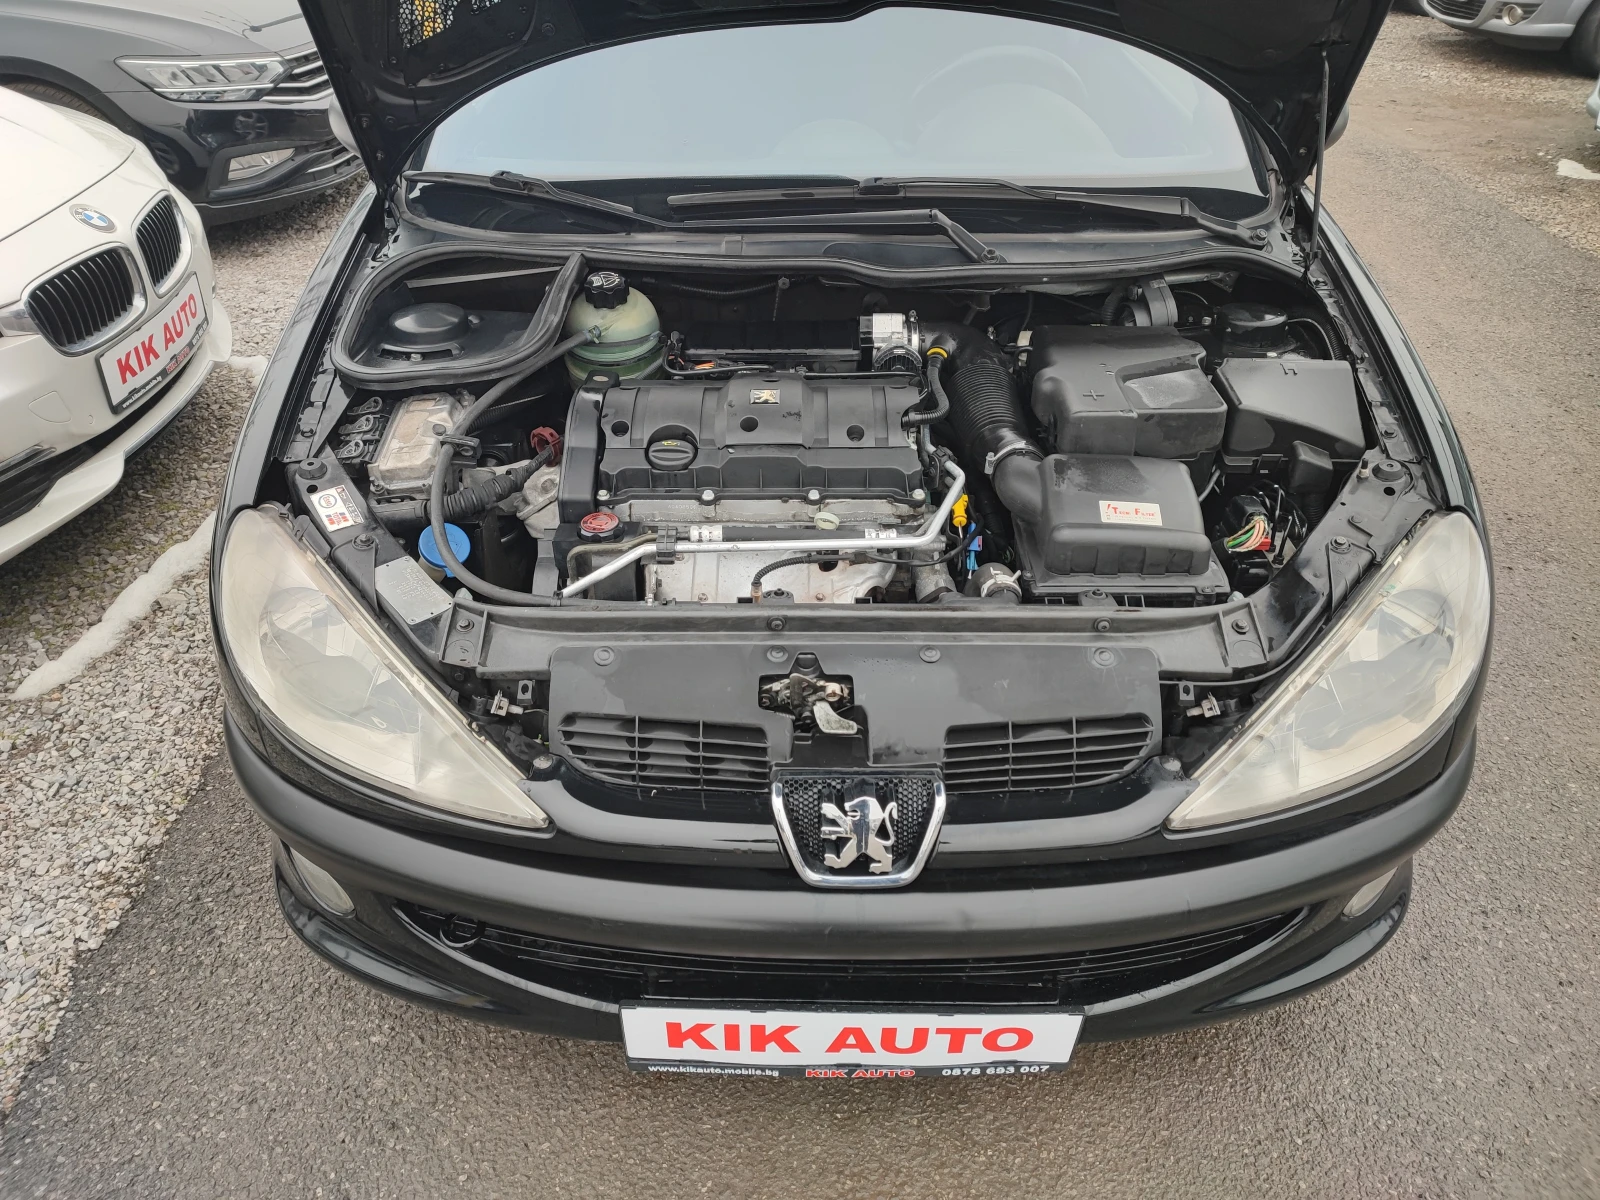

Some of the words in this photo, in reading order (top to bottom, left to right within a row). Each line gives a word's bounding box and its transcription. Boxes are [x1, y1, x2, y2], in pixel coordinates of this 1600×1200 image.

[116, 335, 160, 384] KIK
[163, 293, 197, 350] AUTO
[665, 1021, 800, 1054] KIK
[825, 1026, 1034, 1055] AUTO
[647, 1065, 780, 1078] www.kikauto.mobile.bg
[805, 1069, 848, 1078] KIK
[850, 1069, 916, 1078] AUTO
[941, 1066, 981, 1076] 0878
[985, 1065, 1015, 1075] 693
[1019, 1064, 1050, 1074] 007
